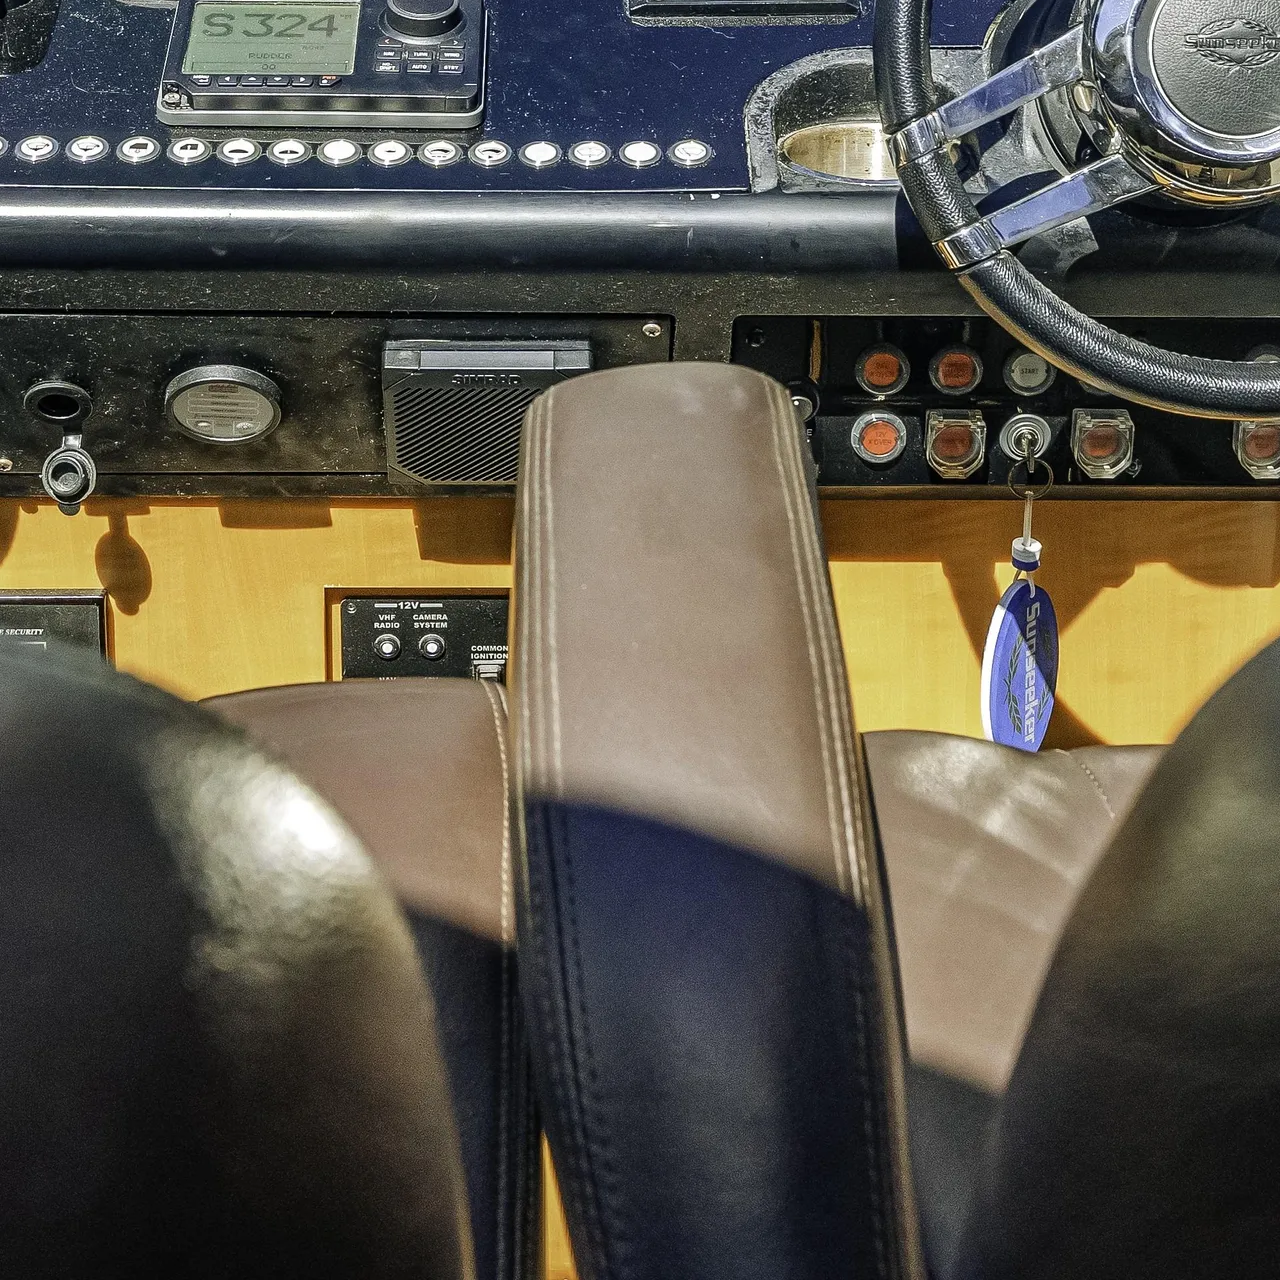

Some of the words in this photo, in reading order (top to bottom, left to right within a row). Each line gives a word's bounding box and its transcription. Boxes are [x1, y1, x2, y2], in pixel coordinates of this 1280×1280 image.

[248, 52, 293, 60] RUDDER
[398, 602, 420, 610] 12V
[1024, 601, 1041, 744] Sunseeker
